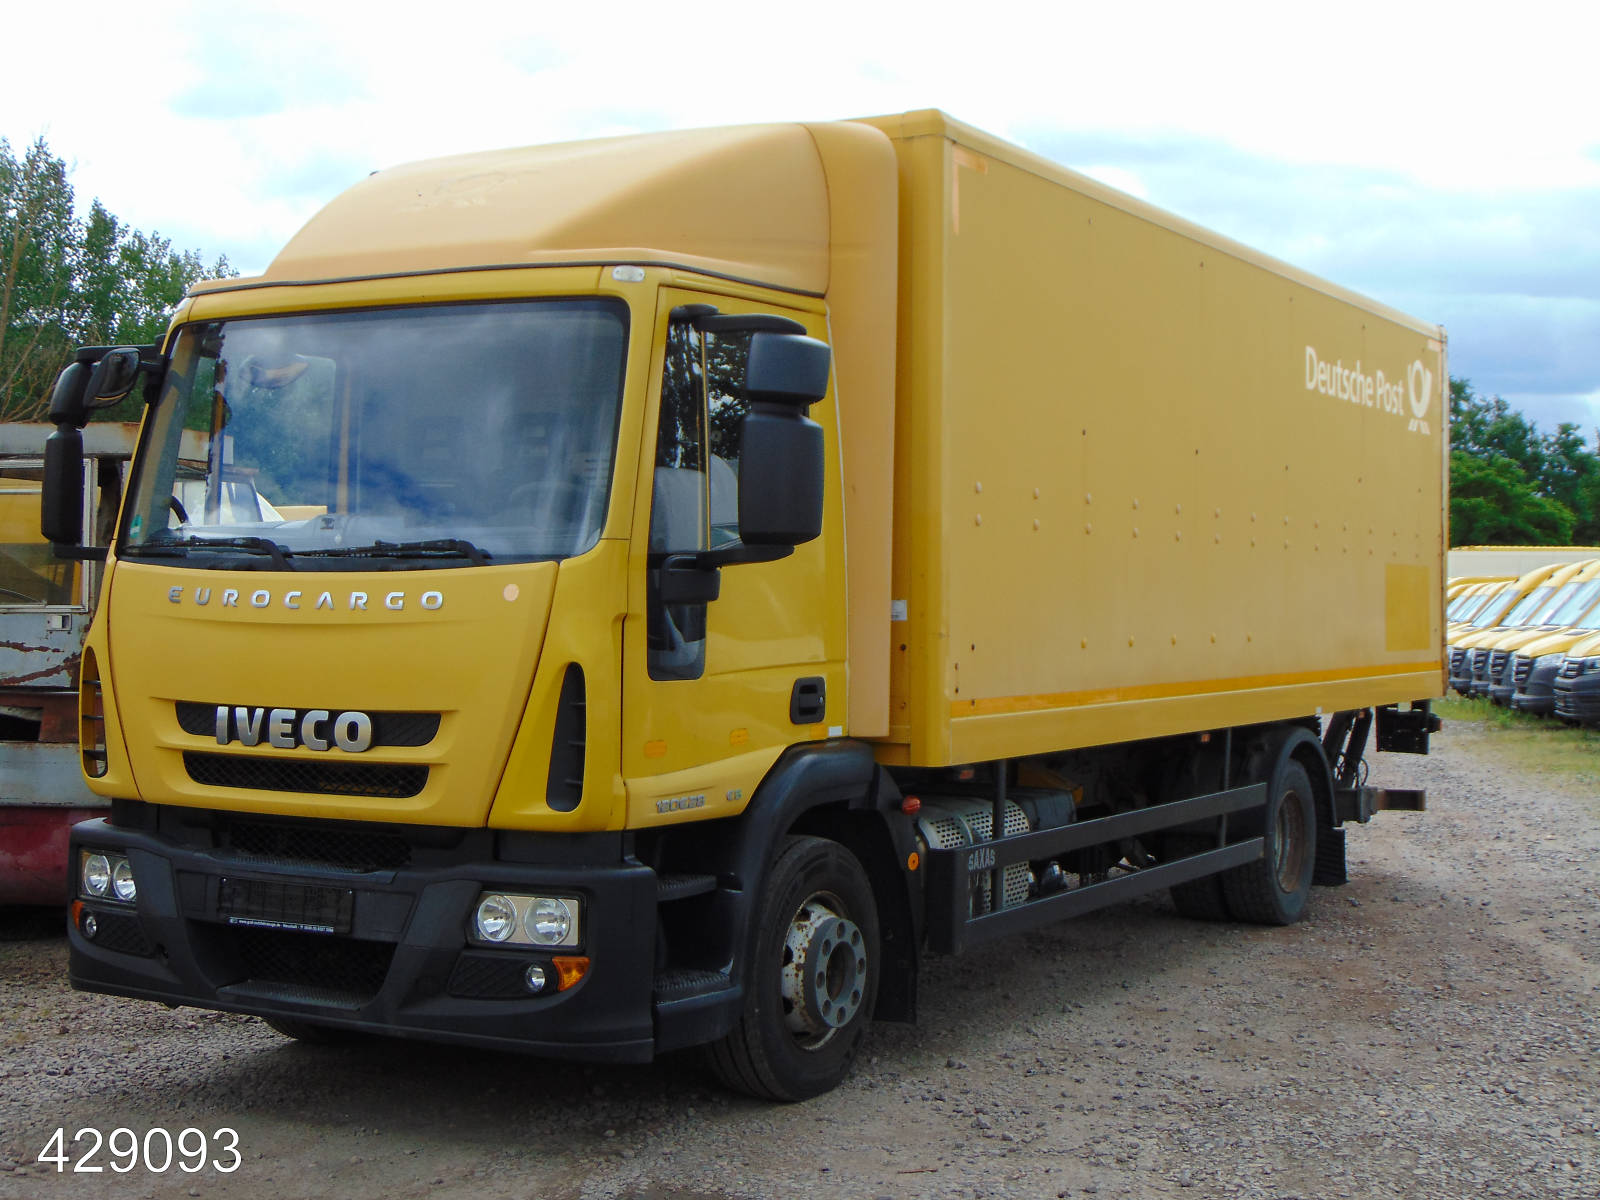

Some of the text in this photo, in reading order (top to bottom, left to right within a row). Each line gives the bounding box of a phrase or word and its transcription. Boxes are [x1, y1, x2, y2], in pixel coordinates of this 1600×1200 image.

[1305, 345, 1404, 416] Deutsche Post
[168, 586, 443, 610] EUROCARGO
[216, 705, 372, 753] IVECO
